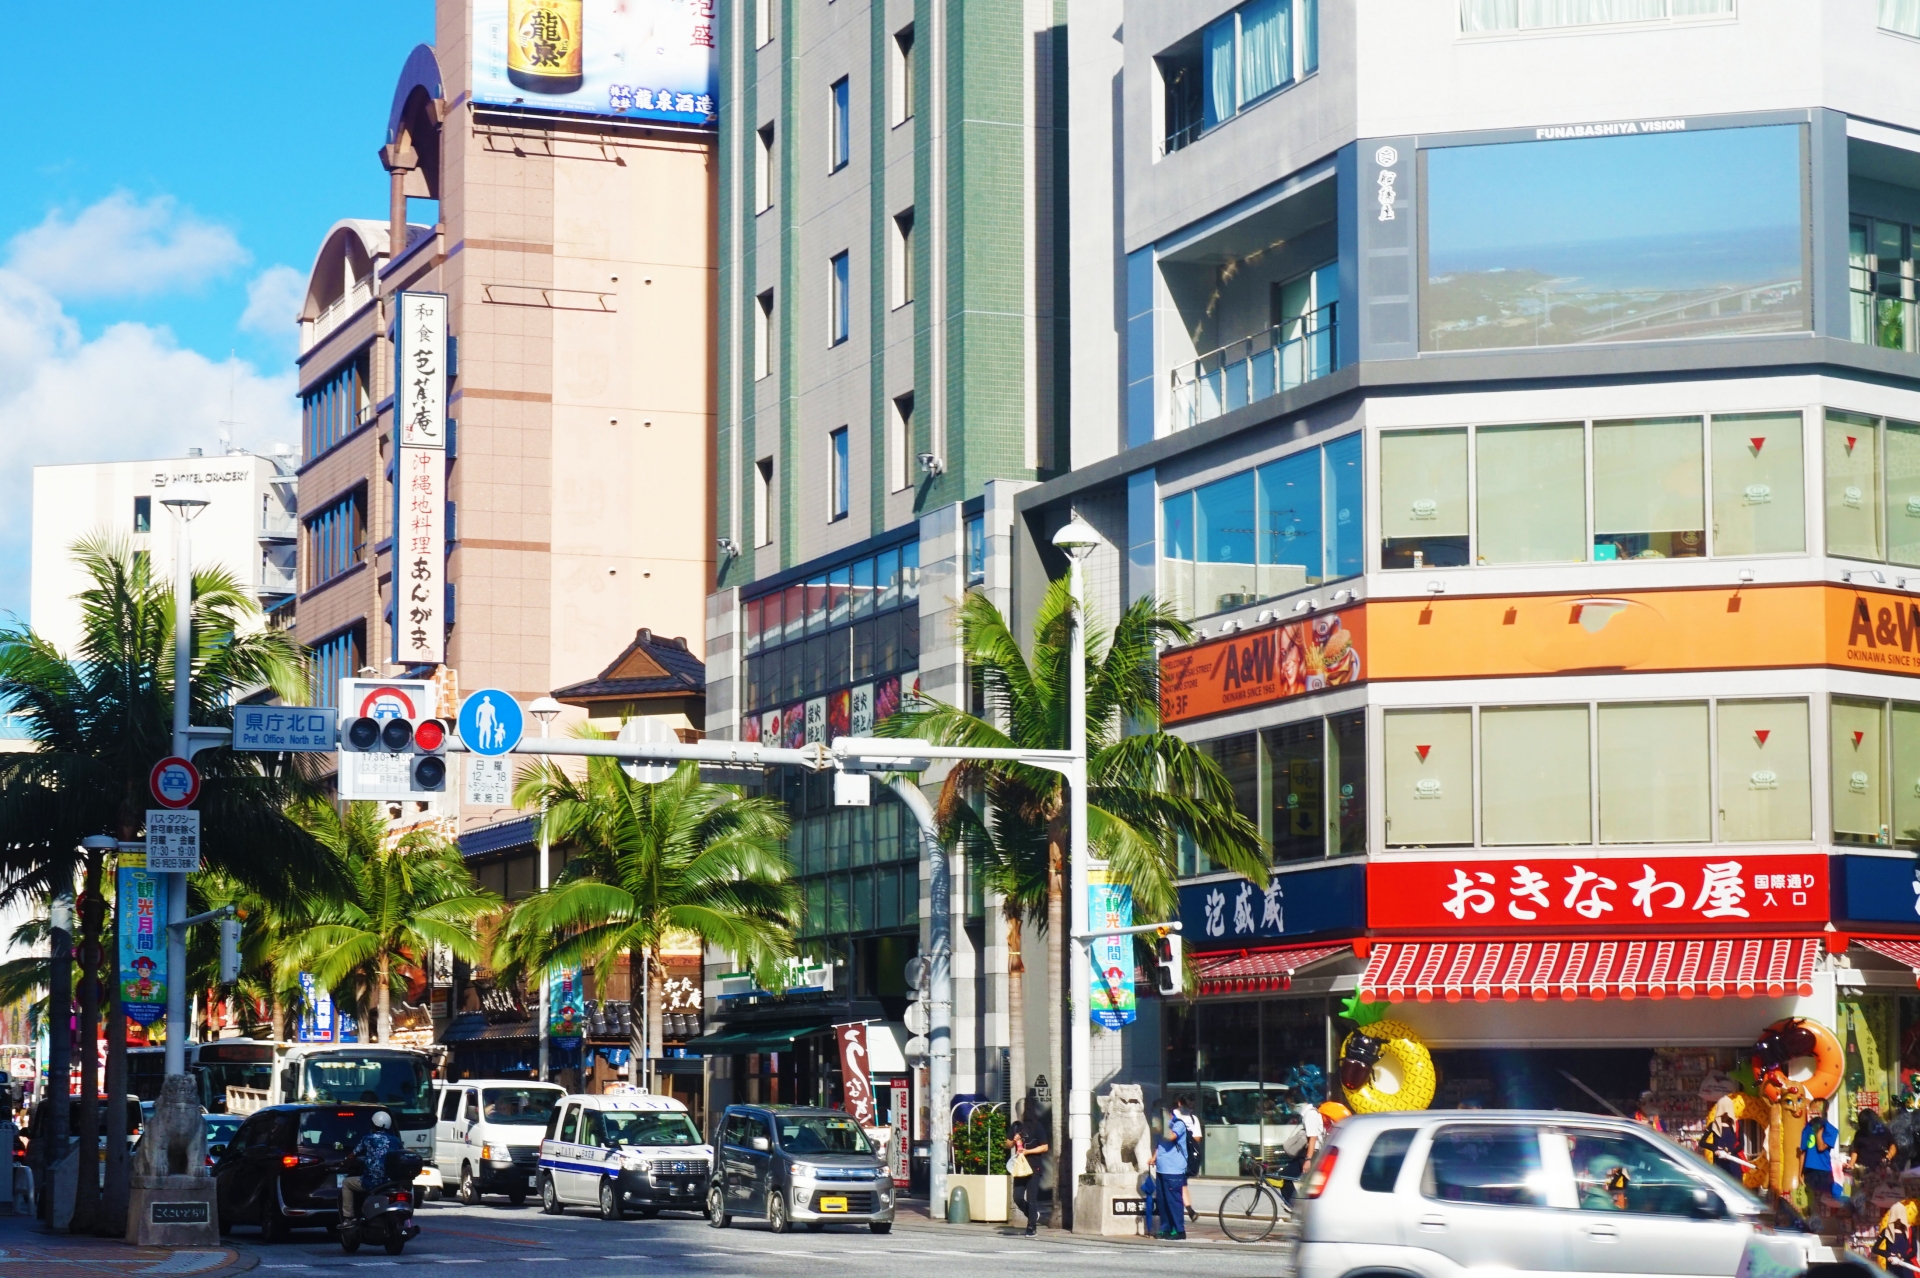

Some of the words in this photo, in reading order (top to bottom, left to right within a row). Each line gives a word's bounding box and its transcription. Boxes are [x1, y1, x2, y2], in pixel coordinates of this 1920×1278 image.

[530, 11, 561, 67] 龍泉
[633, 88, 714, 114] 龍泉酒造
[1536, 122, 1638, 139] FUNABASHIYA
[1640, 119, 1686, 132] VISION
[414, 303, 434, 342] 和食
[205, 470, 249, 483] GRACERY
[411, 452, 432, 555] 沖縄地料理
[409, 556, 433, 650] あんがま
[1223, 633, 1277, 691] A&W
[1847, 649, 1886, 664] OKINAWA
[1888, 654, 1911, 666] SINCE
[1195, 663, 1212, 675] STREET
[1183, 679, 1198, 690] STORE
[1222, 690, 1247, 704] OKINAWA
[1247, 687, 1262, 699] SINCE
[1262, 683, 1276, 696] 1963
[245, 713, 325, 732] 県庁北口
[243, 734, 259, 744] Pref.
[263, 734, 285, 744] Office
[289, 735, 310, 745] North
[313, 735, 327, 745] Ent.
[472, 771, 482, 781] 12
[497, 772, 507, 782] 18
[473, 793, 505, 804] 実施日
[150, 825, 197, 835] 許可車を除く
[150, 846, 169, 857] 17:30
[178, 846, 196, 857] 19:00
[1754, 873, 1815, 890] 国際通り
[1442, 860, 1750, 920] おきなわ屋
[1763, 892, 1807, 906] 入口
[664, 977, 693, 993] 和食
[661, 990, 703, 1011] 蕉庵
[844, 1029, 872, 1125] うなぎ
[608, 1102, 671, 1110] TAXI
[416, 1133, 427, 1143] 47
[561, 1146, 575, 1157] TAXI
[155, 1208, 205, 1218] こくさいどおり
